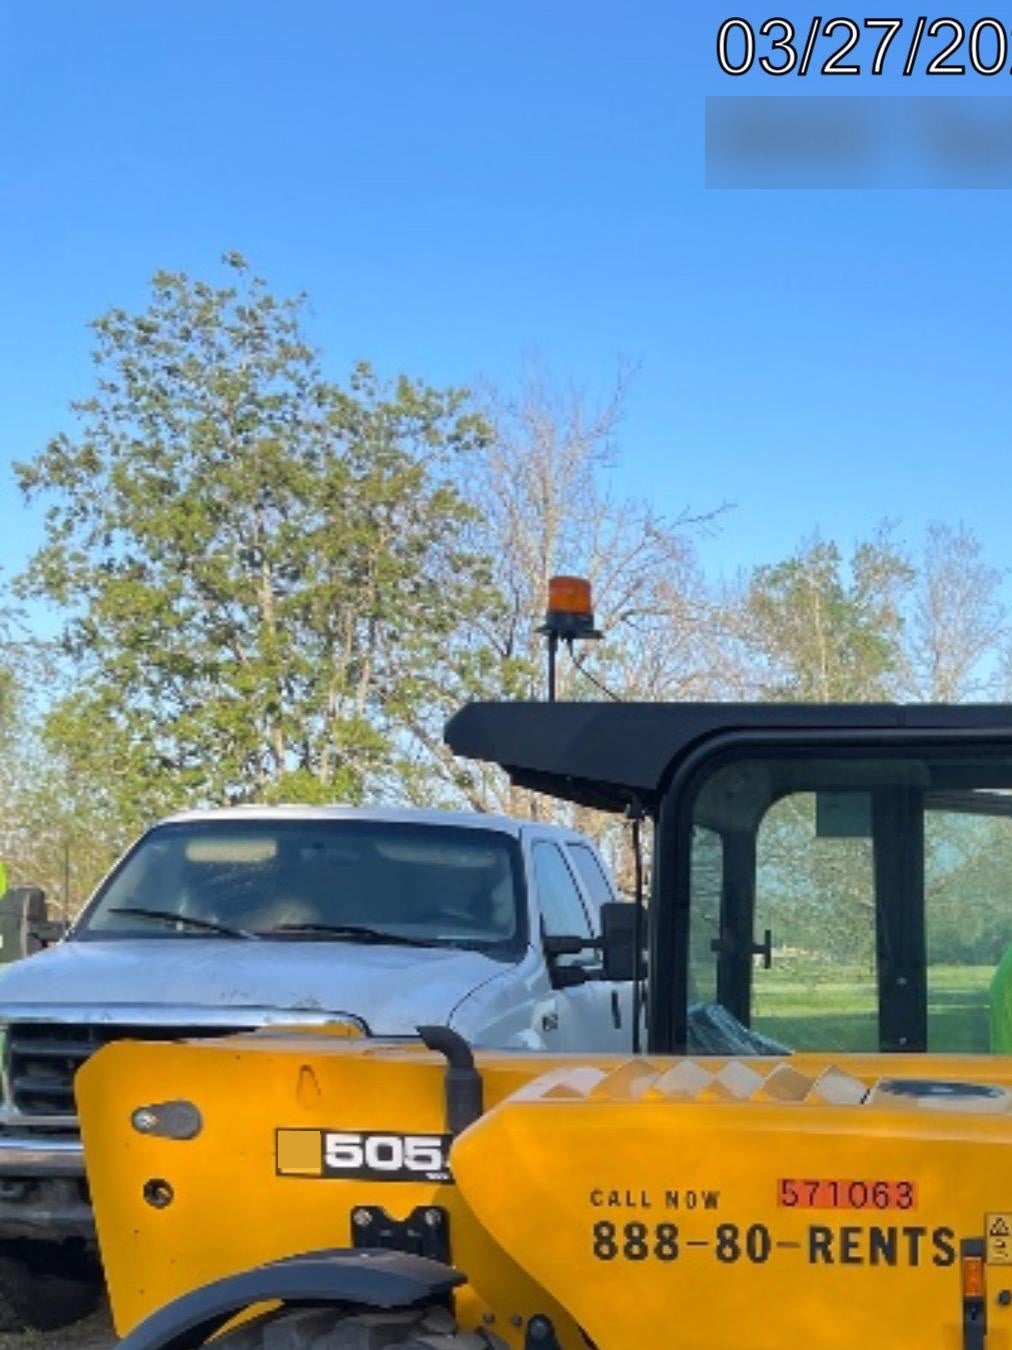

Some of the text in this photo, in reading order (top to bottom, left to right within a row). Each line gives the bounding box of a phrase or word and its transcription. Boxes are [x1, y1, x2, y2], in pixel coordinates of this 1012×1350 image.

[325, 1133, 450, 1172] 505
[590, 1188, 720, 1210] CALL NOW
[781, 1179, 913, 1210] 571063
[593, 1220, 957, 1267] 888-80-RENTS
